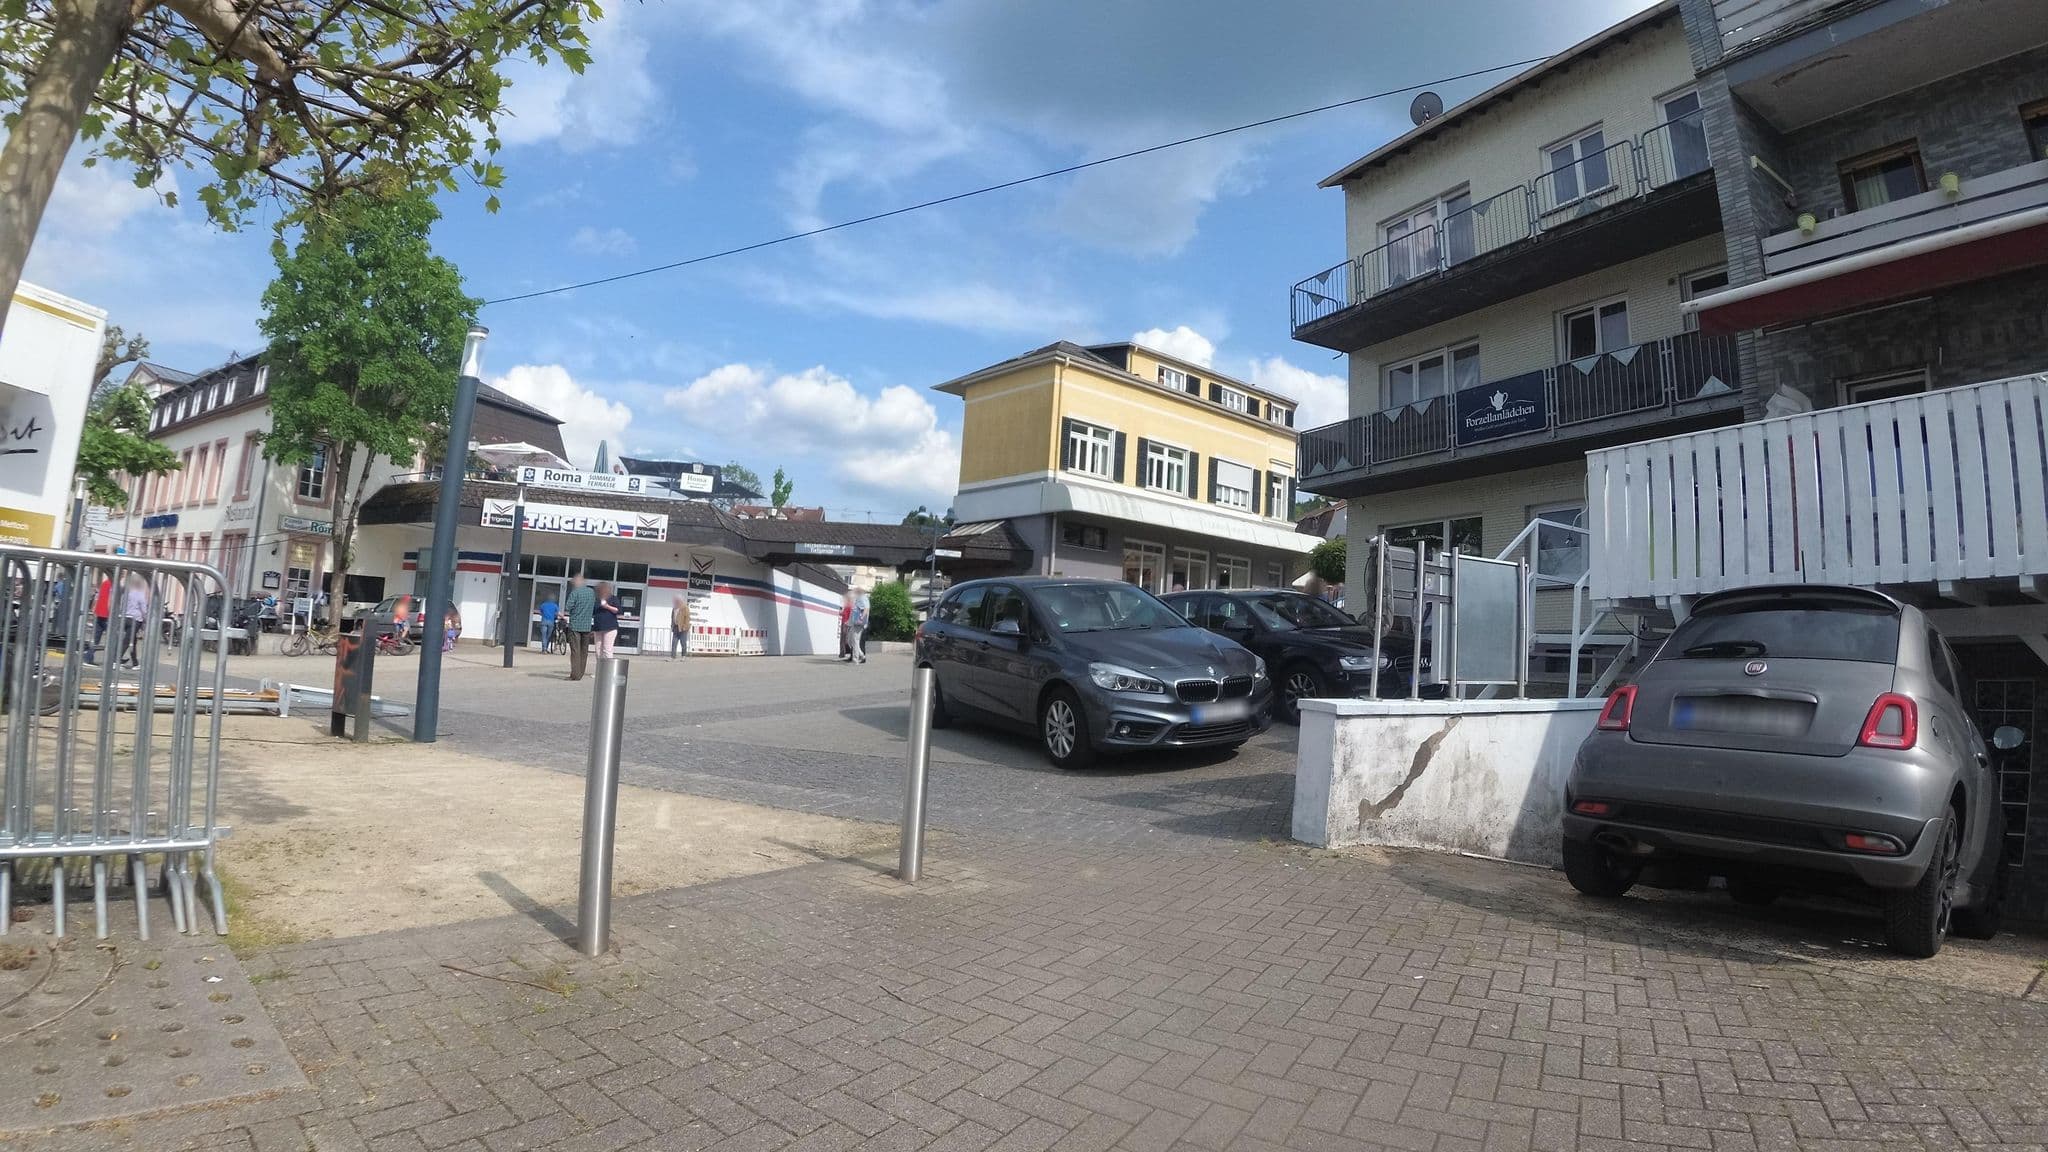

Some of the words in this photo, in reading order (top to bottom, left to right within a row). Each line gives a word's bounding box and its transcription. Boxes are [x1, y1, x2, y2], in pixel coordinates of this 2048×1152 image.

[1465, 404, 1535, 427] Porzellanlädchen
[543, 469, 582, 483] Roma
[526, 512, 620, 537] TRIGEMA
